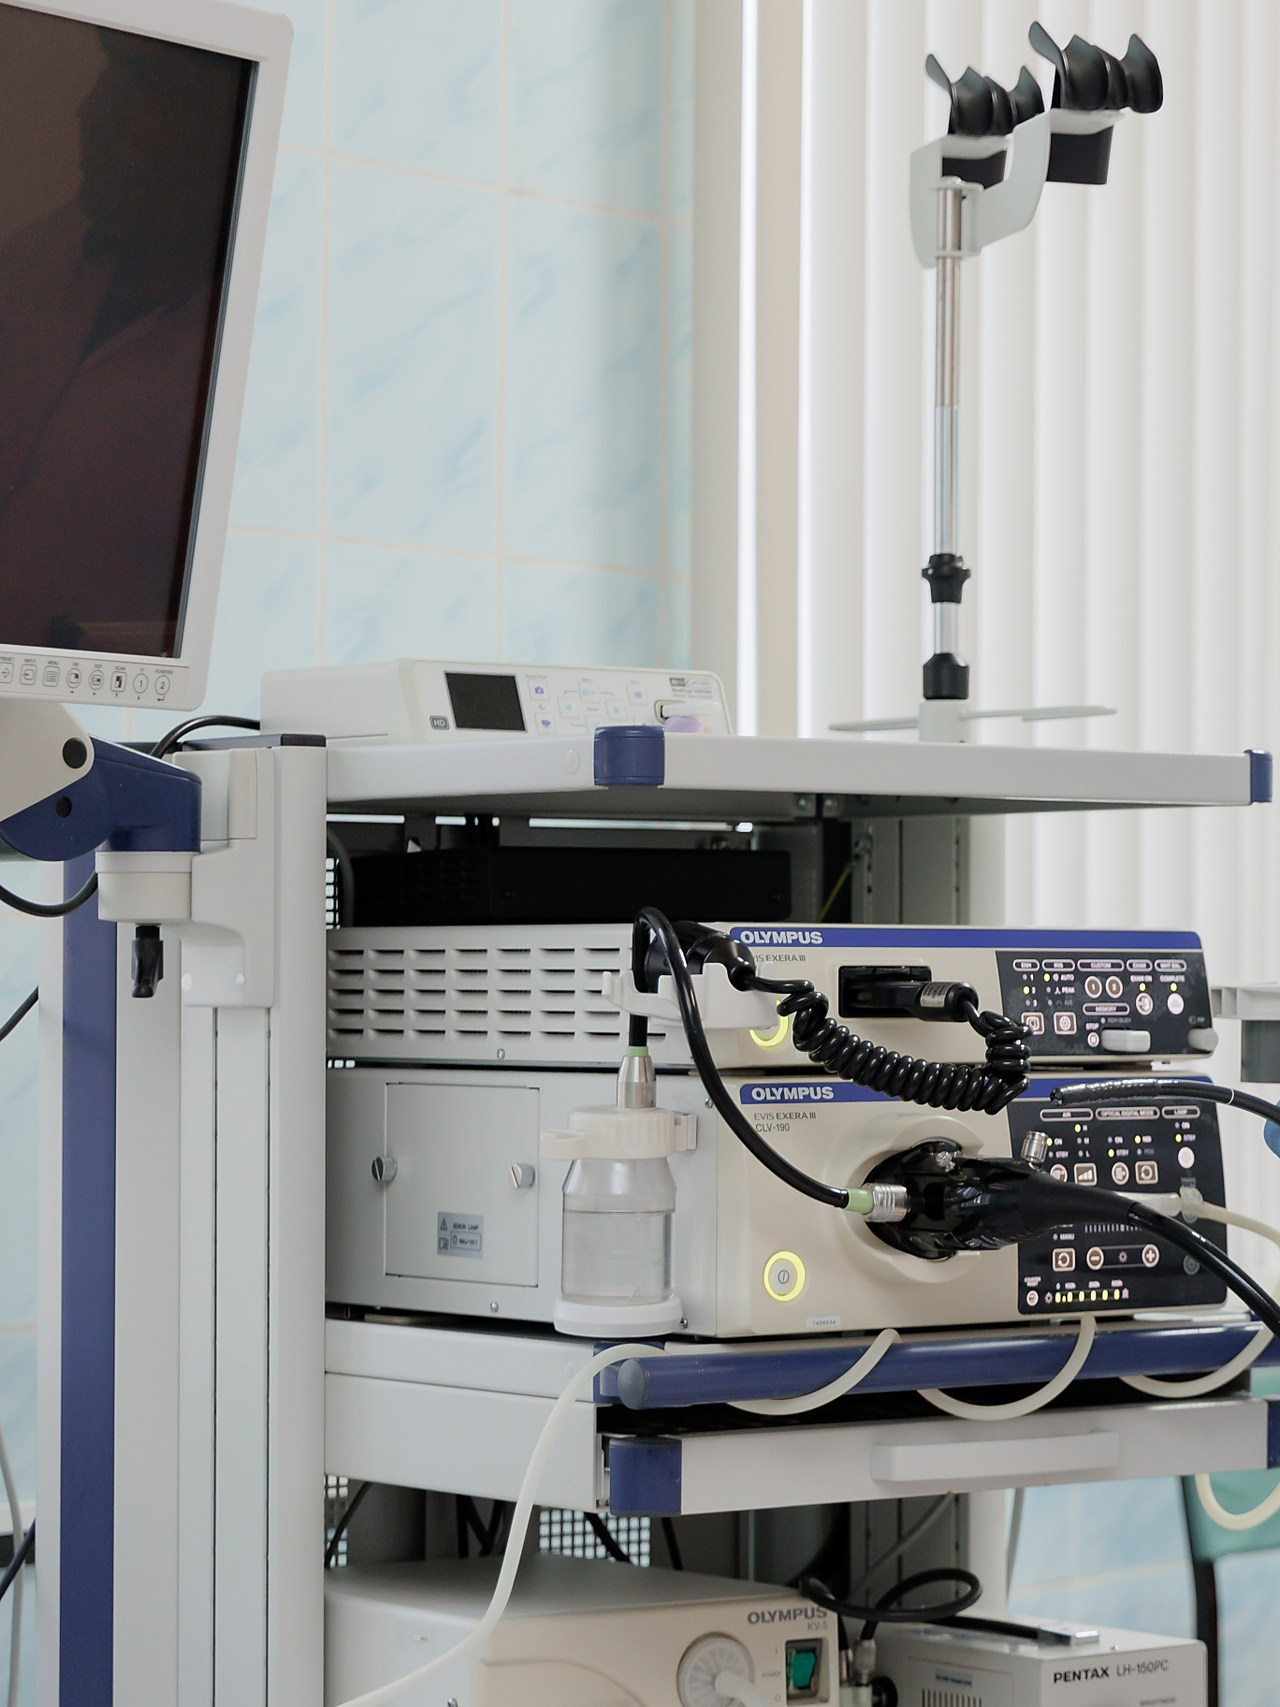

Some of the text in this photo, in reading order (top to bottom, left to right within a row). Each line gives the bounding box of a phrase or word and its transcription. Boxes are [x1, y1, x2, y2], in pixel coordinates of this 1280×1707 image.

[740, 930, 823, 944] OLYMPUS
[766, 954, 798, 962] EXERA
[1060, 973, 1075, 981] AUTO
[1061, 986, 1076, 994] PEAK
[751, 1086, 834, 1100] OLYMPUS
[776, 1112, 808, 1120] EXERA
[756, 1123, 790, 1132] CLV-190
[747, 1606, 828, 1624] OLYMPUS
[1053, 1666, 1109, 1683] PENTAX
